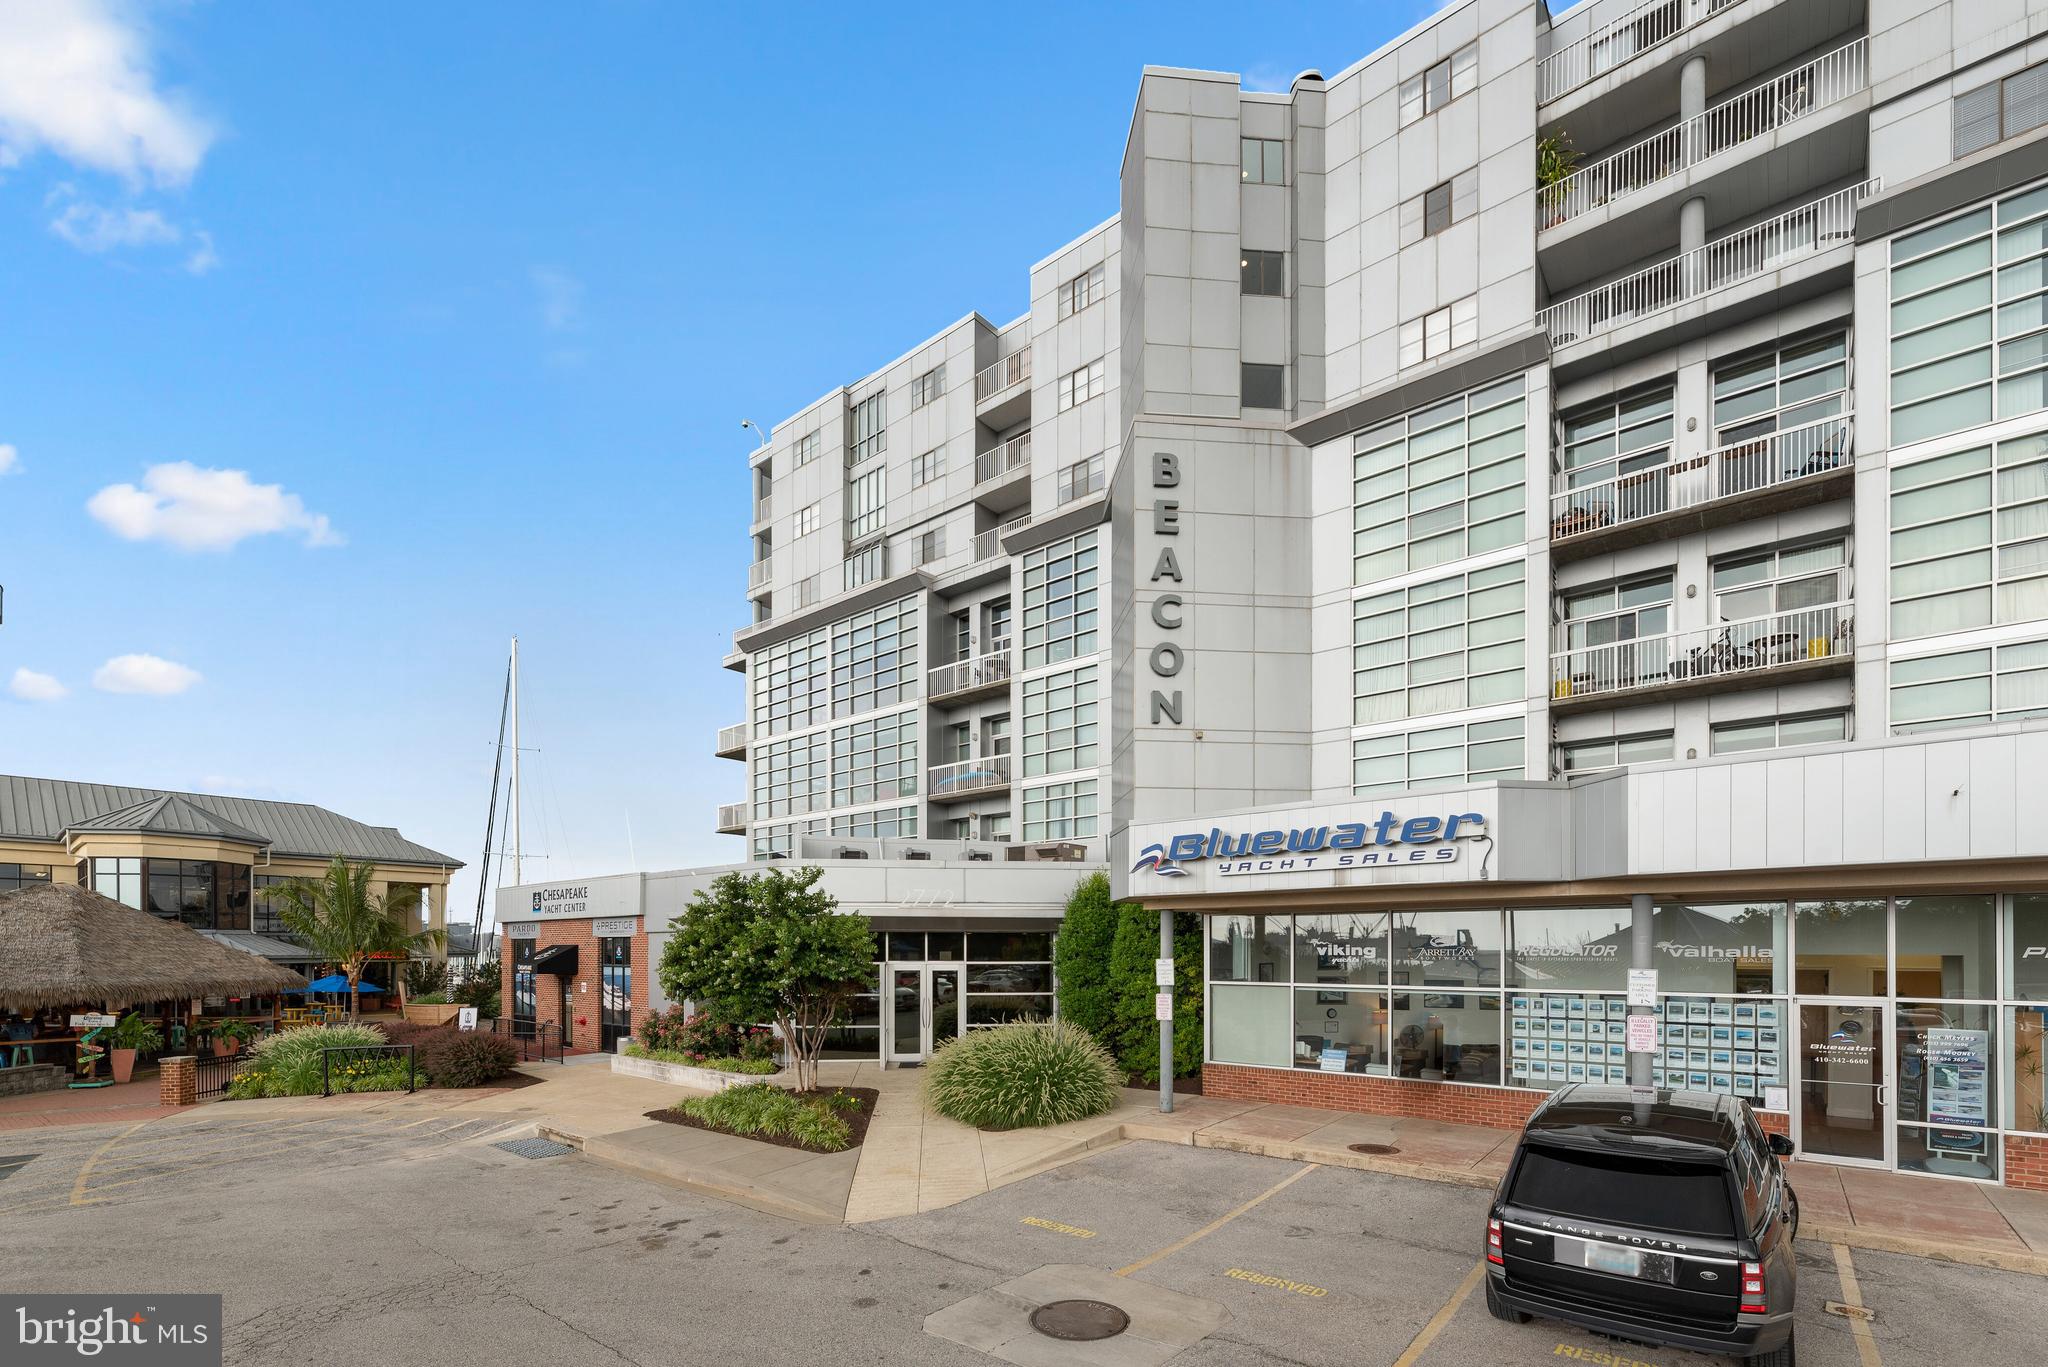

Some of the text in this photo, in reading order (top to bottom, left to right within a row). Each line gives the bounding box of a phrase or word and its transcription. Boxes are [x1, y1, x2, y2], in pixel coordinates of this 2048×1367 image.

[1150, 452, 1184, 724] BEACON
[1168, 811, 1486, 861] Bluewater
[1218, 848, 1455, 873] YACHT SALES
[542, 886, 588, 901] CHESAPEAKE
[544, 902, 586, 914] YACHT CENTER
[512, 924, 536, 933] PARDO
[601, 921, 633, 930] PRESTIGE
[1316, 945, 1376, 958] viking
[1415, 945, 1476, 960] JARRETT BAY
[1517, 944, 1618, 956] REGULATOR
[1668, 946, 1773, 957] valhalla
[2022, 946, 2048, 958] P
[1331, 956, 1360, 964] yachts
[1809, 1043, 1876, 1052] Bluewater
[1815, 1057, 1869, 1065] 410-342-6600
[1019, 1216, 1097, 1239] RESERVED
[1542, 1221, 1688, 1251] RANGE ROVER
[1224, 1267, 1329, 1297] RESERVED
